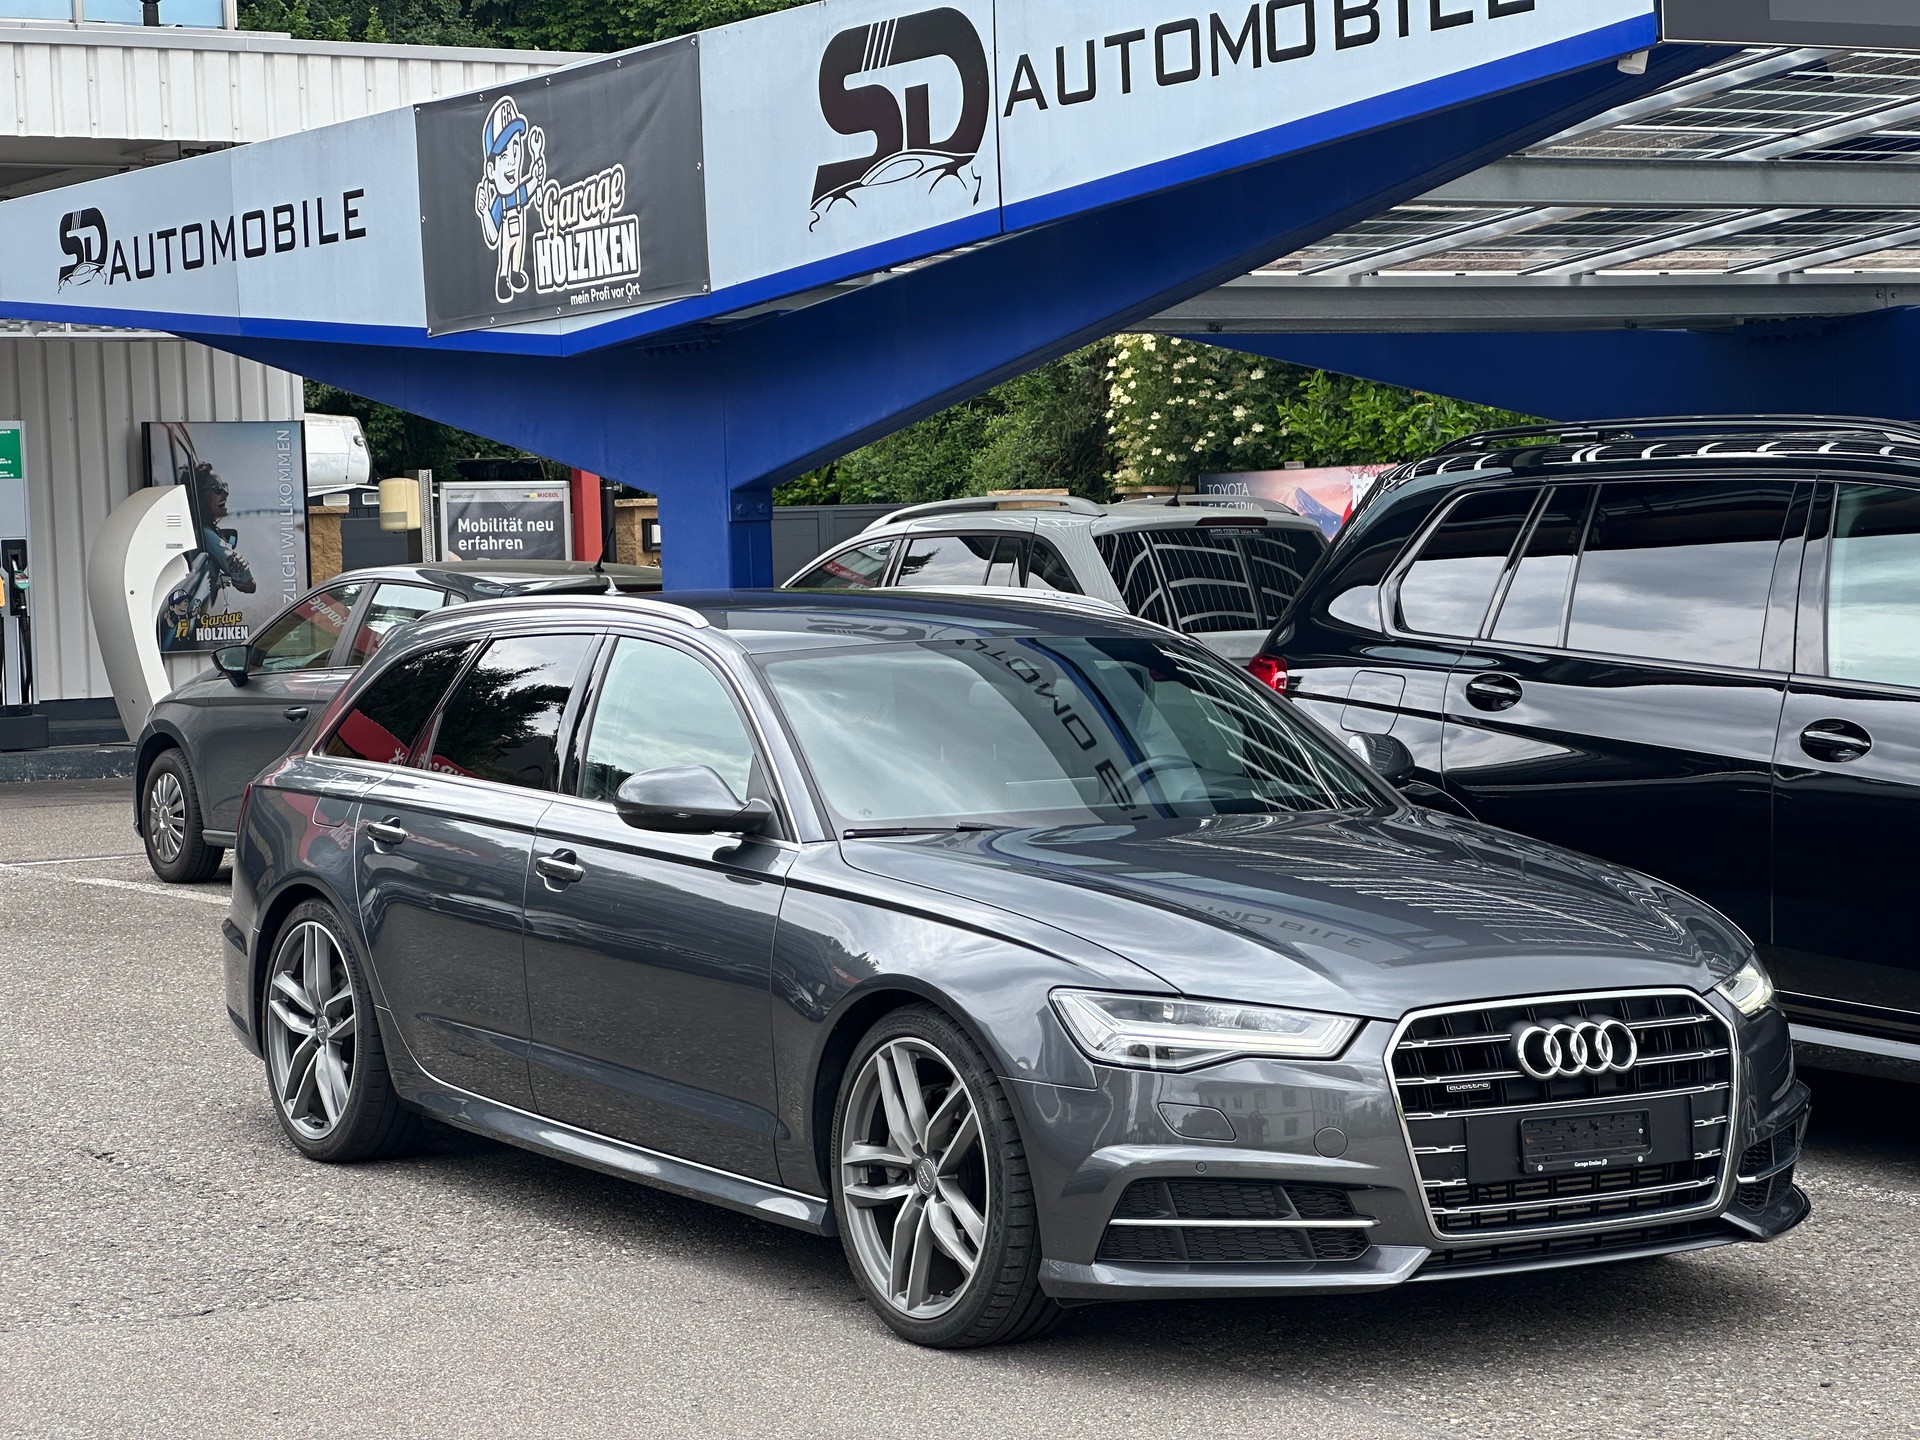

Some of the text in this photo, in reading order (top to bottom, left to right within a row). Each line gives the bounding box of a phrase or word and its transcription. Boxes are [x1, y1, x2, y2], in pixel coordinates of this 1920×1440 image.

[811, 7, 990, 208] SD
[543, 169, 623, 240] Garage
[58, 188, 367, 286] SD AUTOMOBILE
[536, 222, 639, 287] HOLZIKEN
[570, 282, 641, 305] mein Profi vor Ort
[1206, 482, 1250, 496] TOYOTA
[276, 429, 298, 604] ZLICH WILLKOMMEN
[457, 518, 554, 533] Mobilität neu
[458, 536, 524, 551] erfahren
[200, 611, 243, 628] Garage
[196, 626, 249, 641] HOLZIKEN
[1449, 1083, 1489, 1091] quattro
